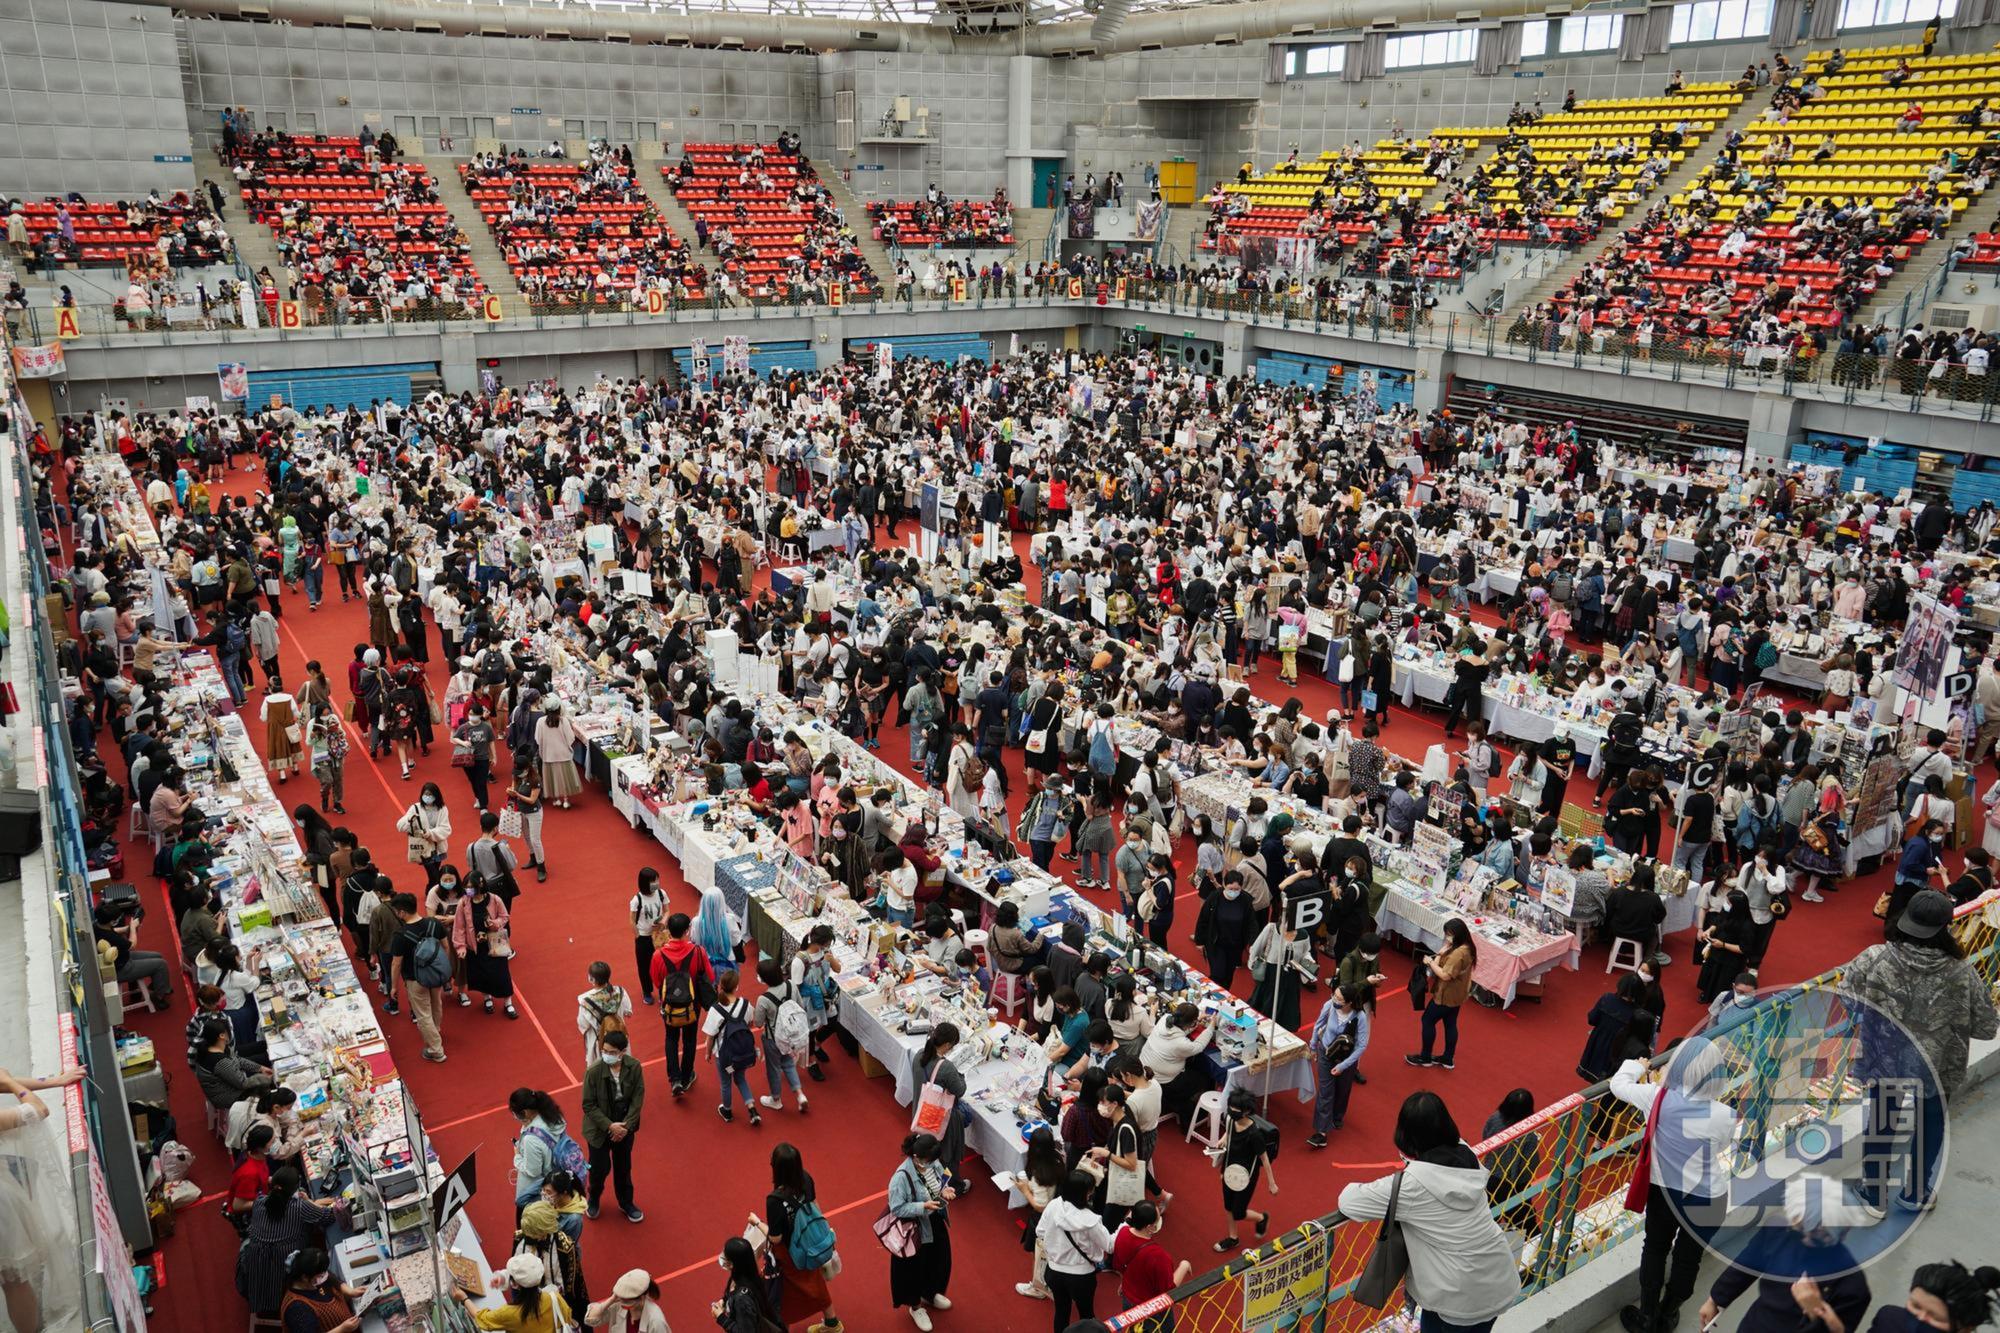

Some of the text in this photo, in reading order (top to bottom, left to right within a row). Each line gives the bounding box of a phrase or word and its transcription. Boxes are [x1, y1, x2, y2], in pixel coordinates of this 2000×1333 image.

[831, 284, 841, 305] E
[955, 280, 965, 300] F
[1070, 277, 1081, 297] G
[1117, 278, 1126, 298] H
[486, 297, 500, 320] C
[649, 291, 662, 313] D
[60, 310, 78, 336] A
[282, 302, 299, 327] B
[696, 359, 707, 368] D
[1951, 673, 1972, 696] D
[1693, 763, 1714, 786] C
[644, 901, 662, 920] NY
[1295, 897, 1324, 930] B
[440, 1172, 470, 1228] A
[1104, 1313, 1130, 1332] YUR
